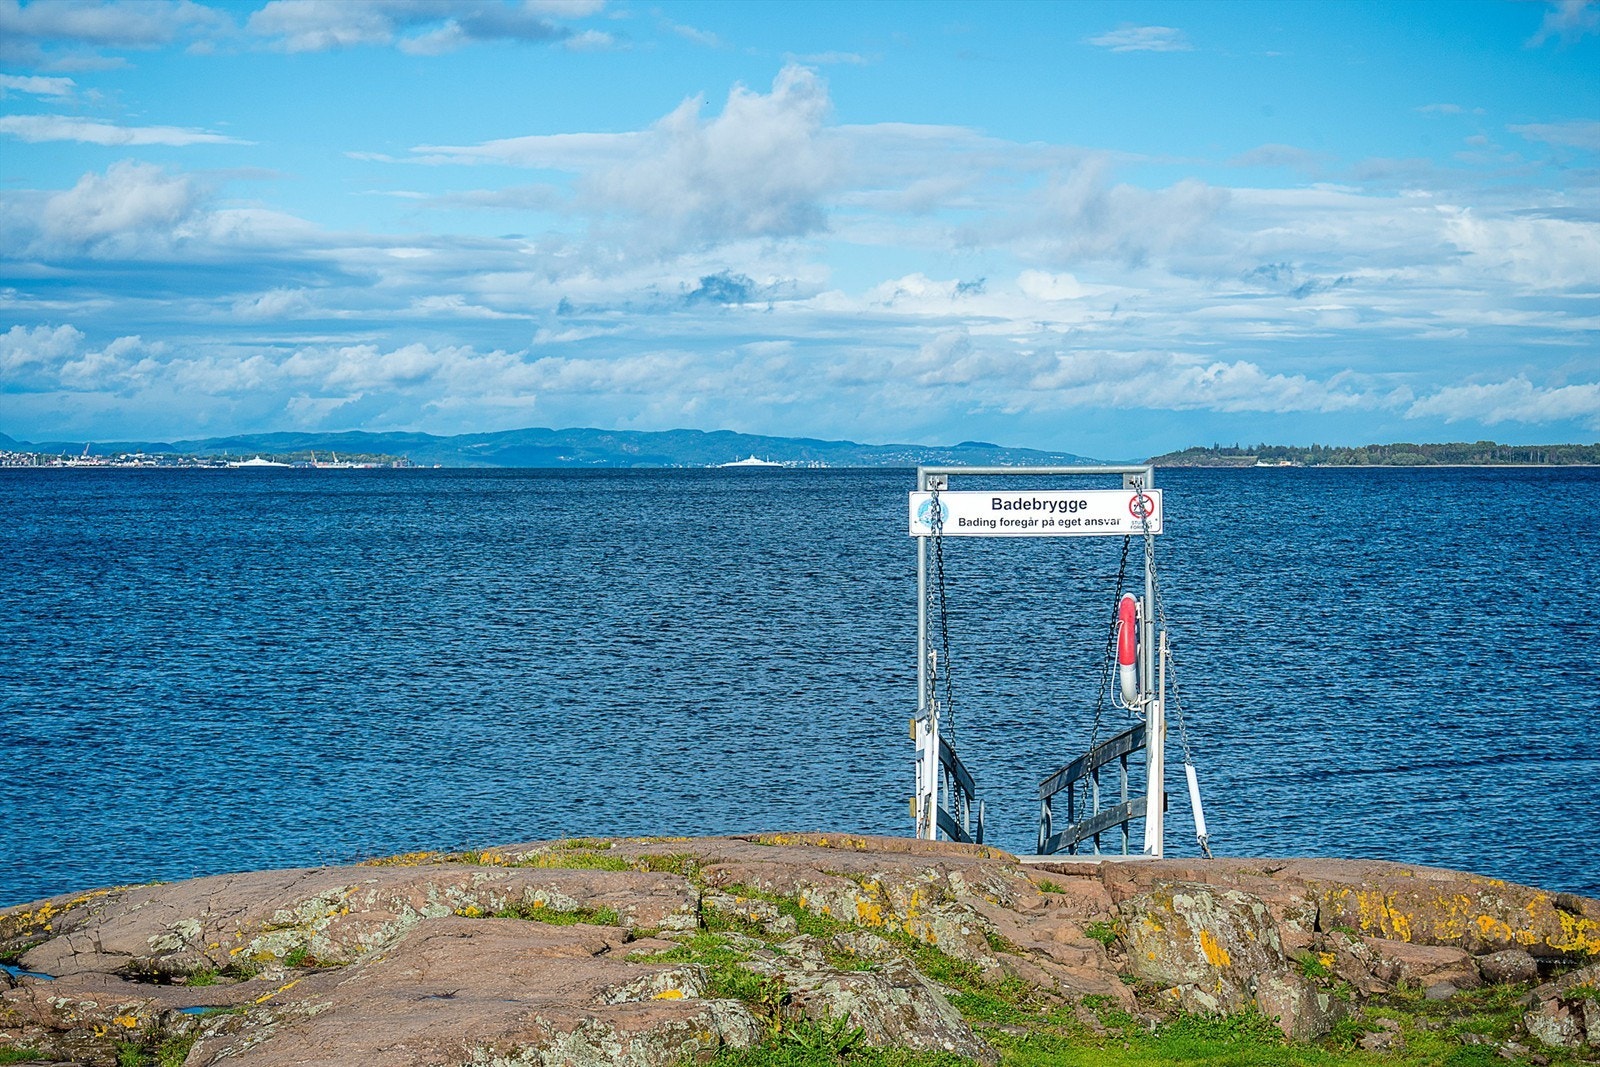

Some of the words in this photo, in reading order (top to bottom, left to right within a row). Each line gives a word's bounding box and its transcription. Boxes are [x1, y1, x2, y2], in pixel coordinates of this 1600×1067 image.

[991, 497, 1088, 513] Badebrygge
[958, 517, 997, 529] Bading
[999, 517, 1039, 529] foregår
[1041, 517, 1055, 529] på
[1057, 518, 1082, 529] eget
[1084, 517, 1122, 527] ansvar
